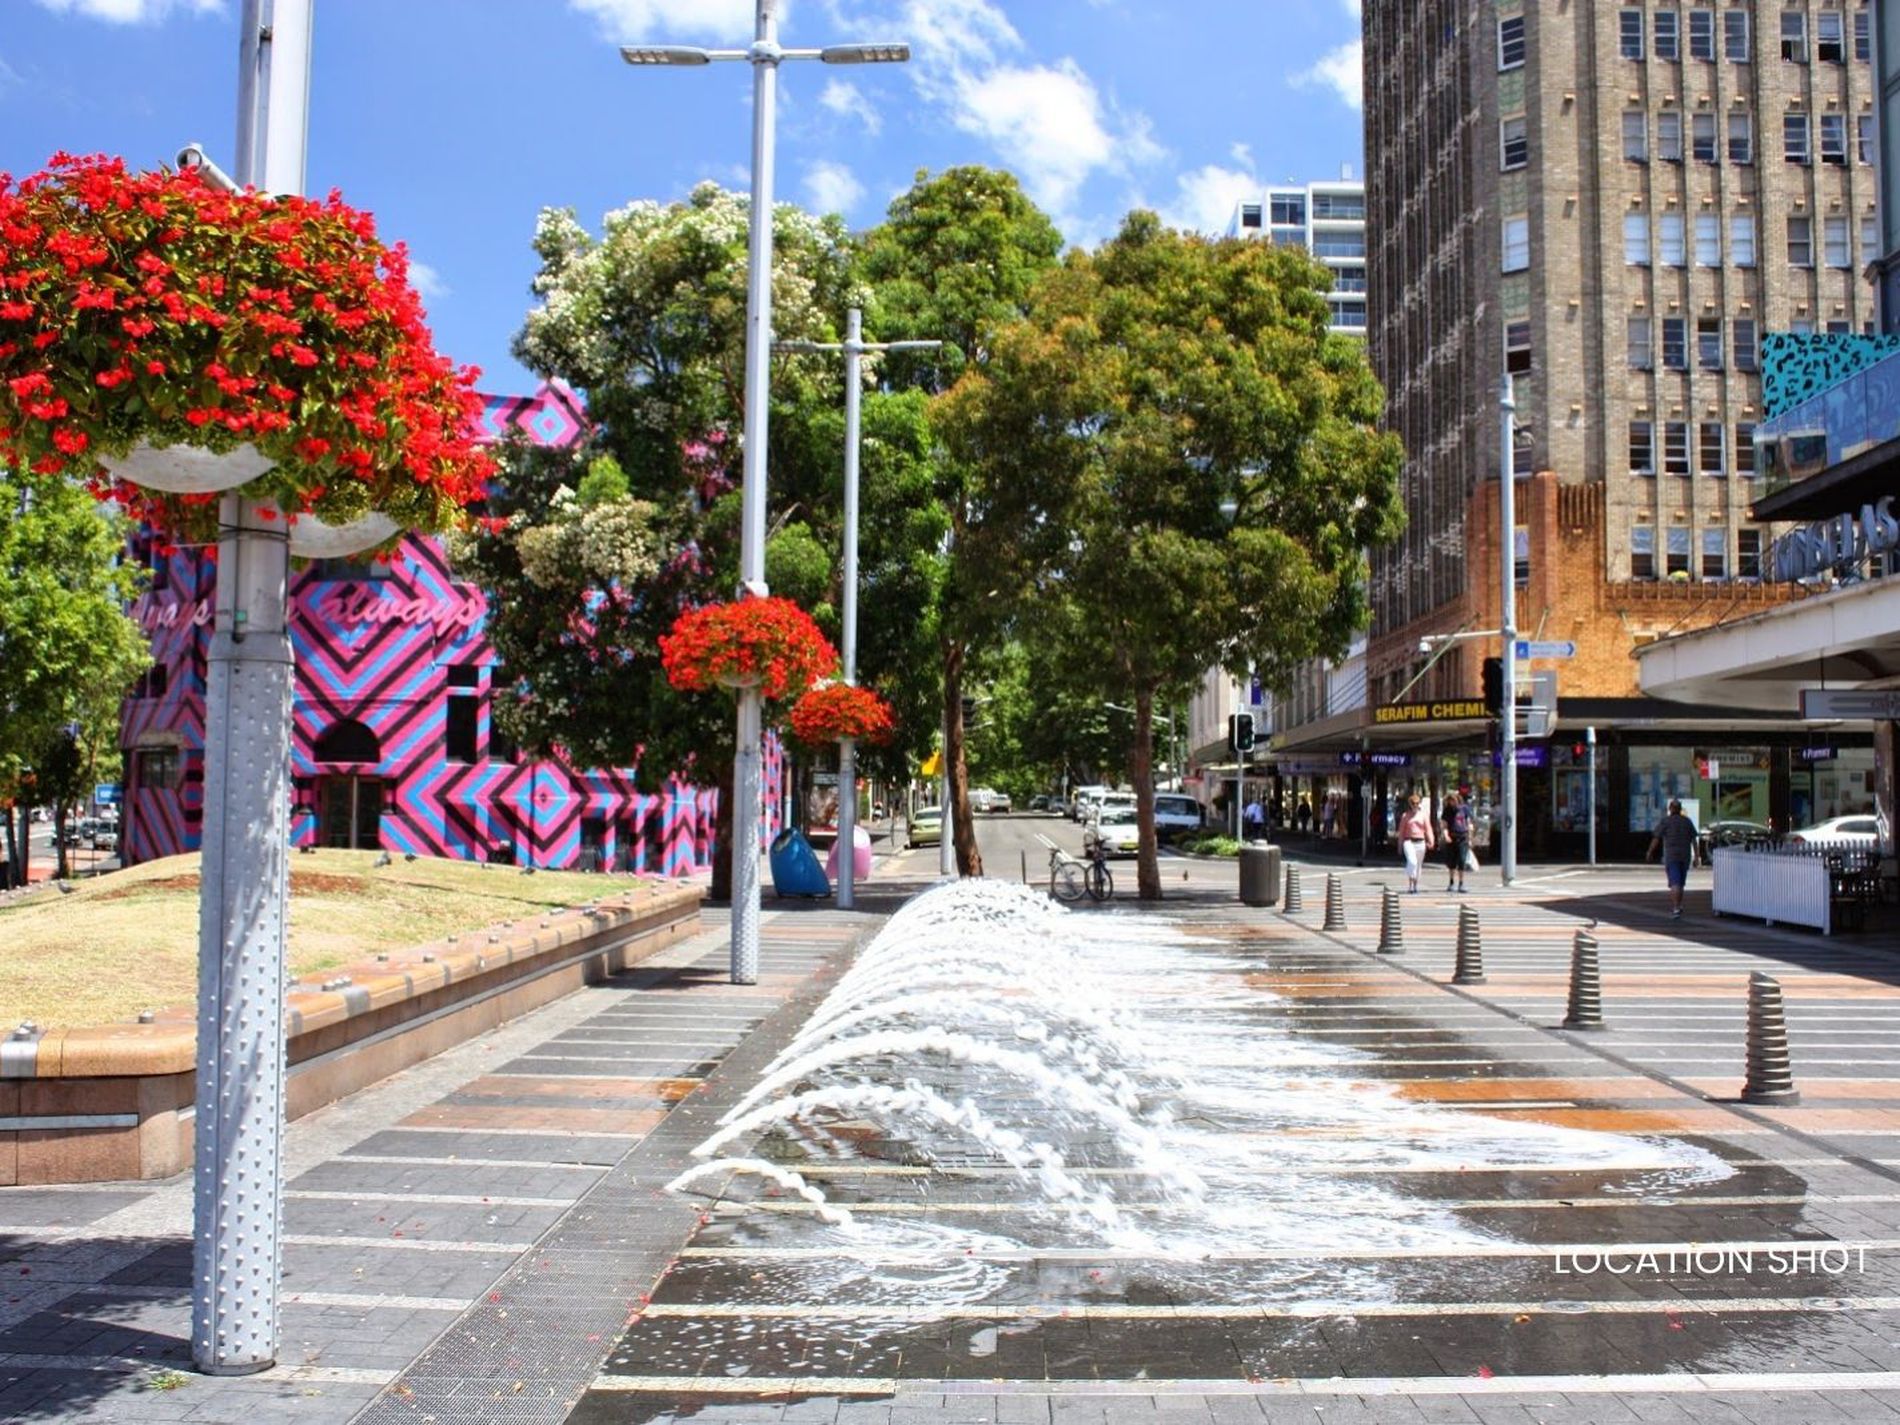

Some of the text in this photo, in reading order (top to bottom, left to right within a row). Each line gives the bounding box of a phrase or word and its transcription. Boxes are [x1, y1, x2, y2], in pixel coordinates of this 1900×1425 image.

[316, 582, 478, 637] always
[1375, 705, 1428, 722] SERAFIM
[1355, 752, 1406, 765] Prmacy
